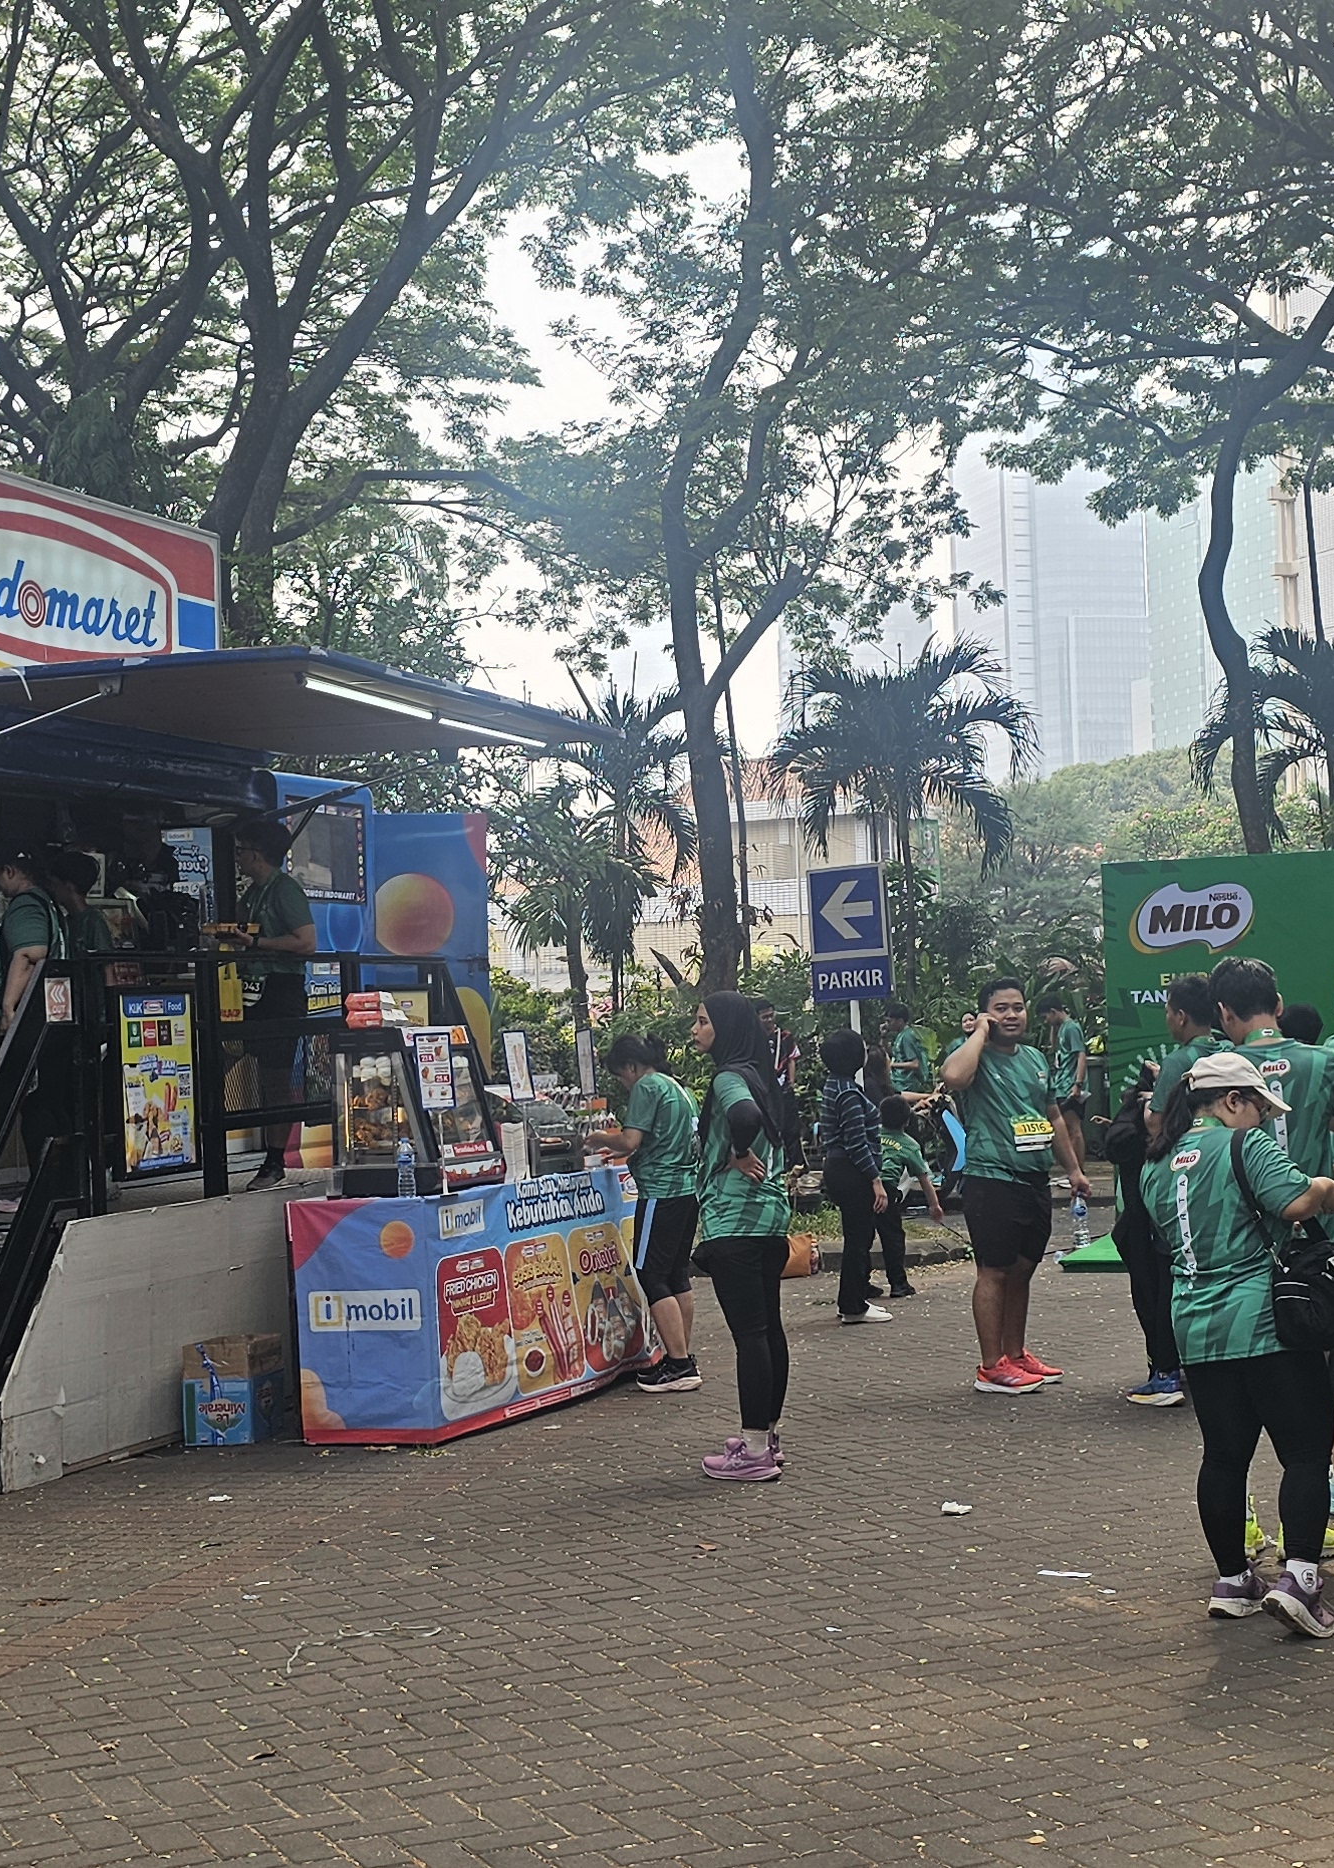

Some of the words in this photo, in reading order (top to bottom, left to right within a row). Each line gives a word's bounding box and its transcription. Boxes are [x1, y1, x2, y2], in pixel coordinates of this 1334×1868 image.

[1148, 903, 1241, 934] MILO
[818, 969, 883, 990] PARKIR
[1130, 990, 1167, 1004] TAN
[168, 1002, 182, 1011] Food
[1262, 1063, 1287, 1073] MILO
[1022, 1122, 1047, 1133] 11516
[1175, 1154, 1197, 1165] MILO
[515, 1181, 539, 1200] Kami
[574, 1188, 604, 1217] Anda
[454, 1205, 482, 1228] mobil
[445, 1279, 465, 1298] FRIED
[466, 1271, 498, 1291] CHICKEN
[346, 1297, 414, 1321] mobil
[198, 1402, 246, 1415] Minerale
[215, 1413, 230, 1427] Le
